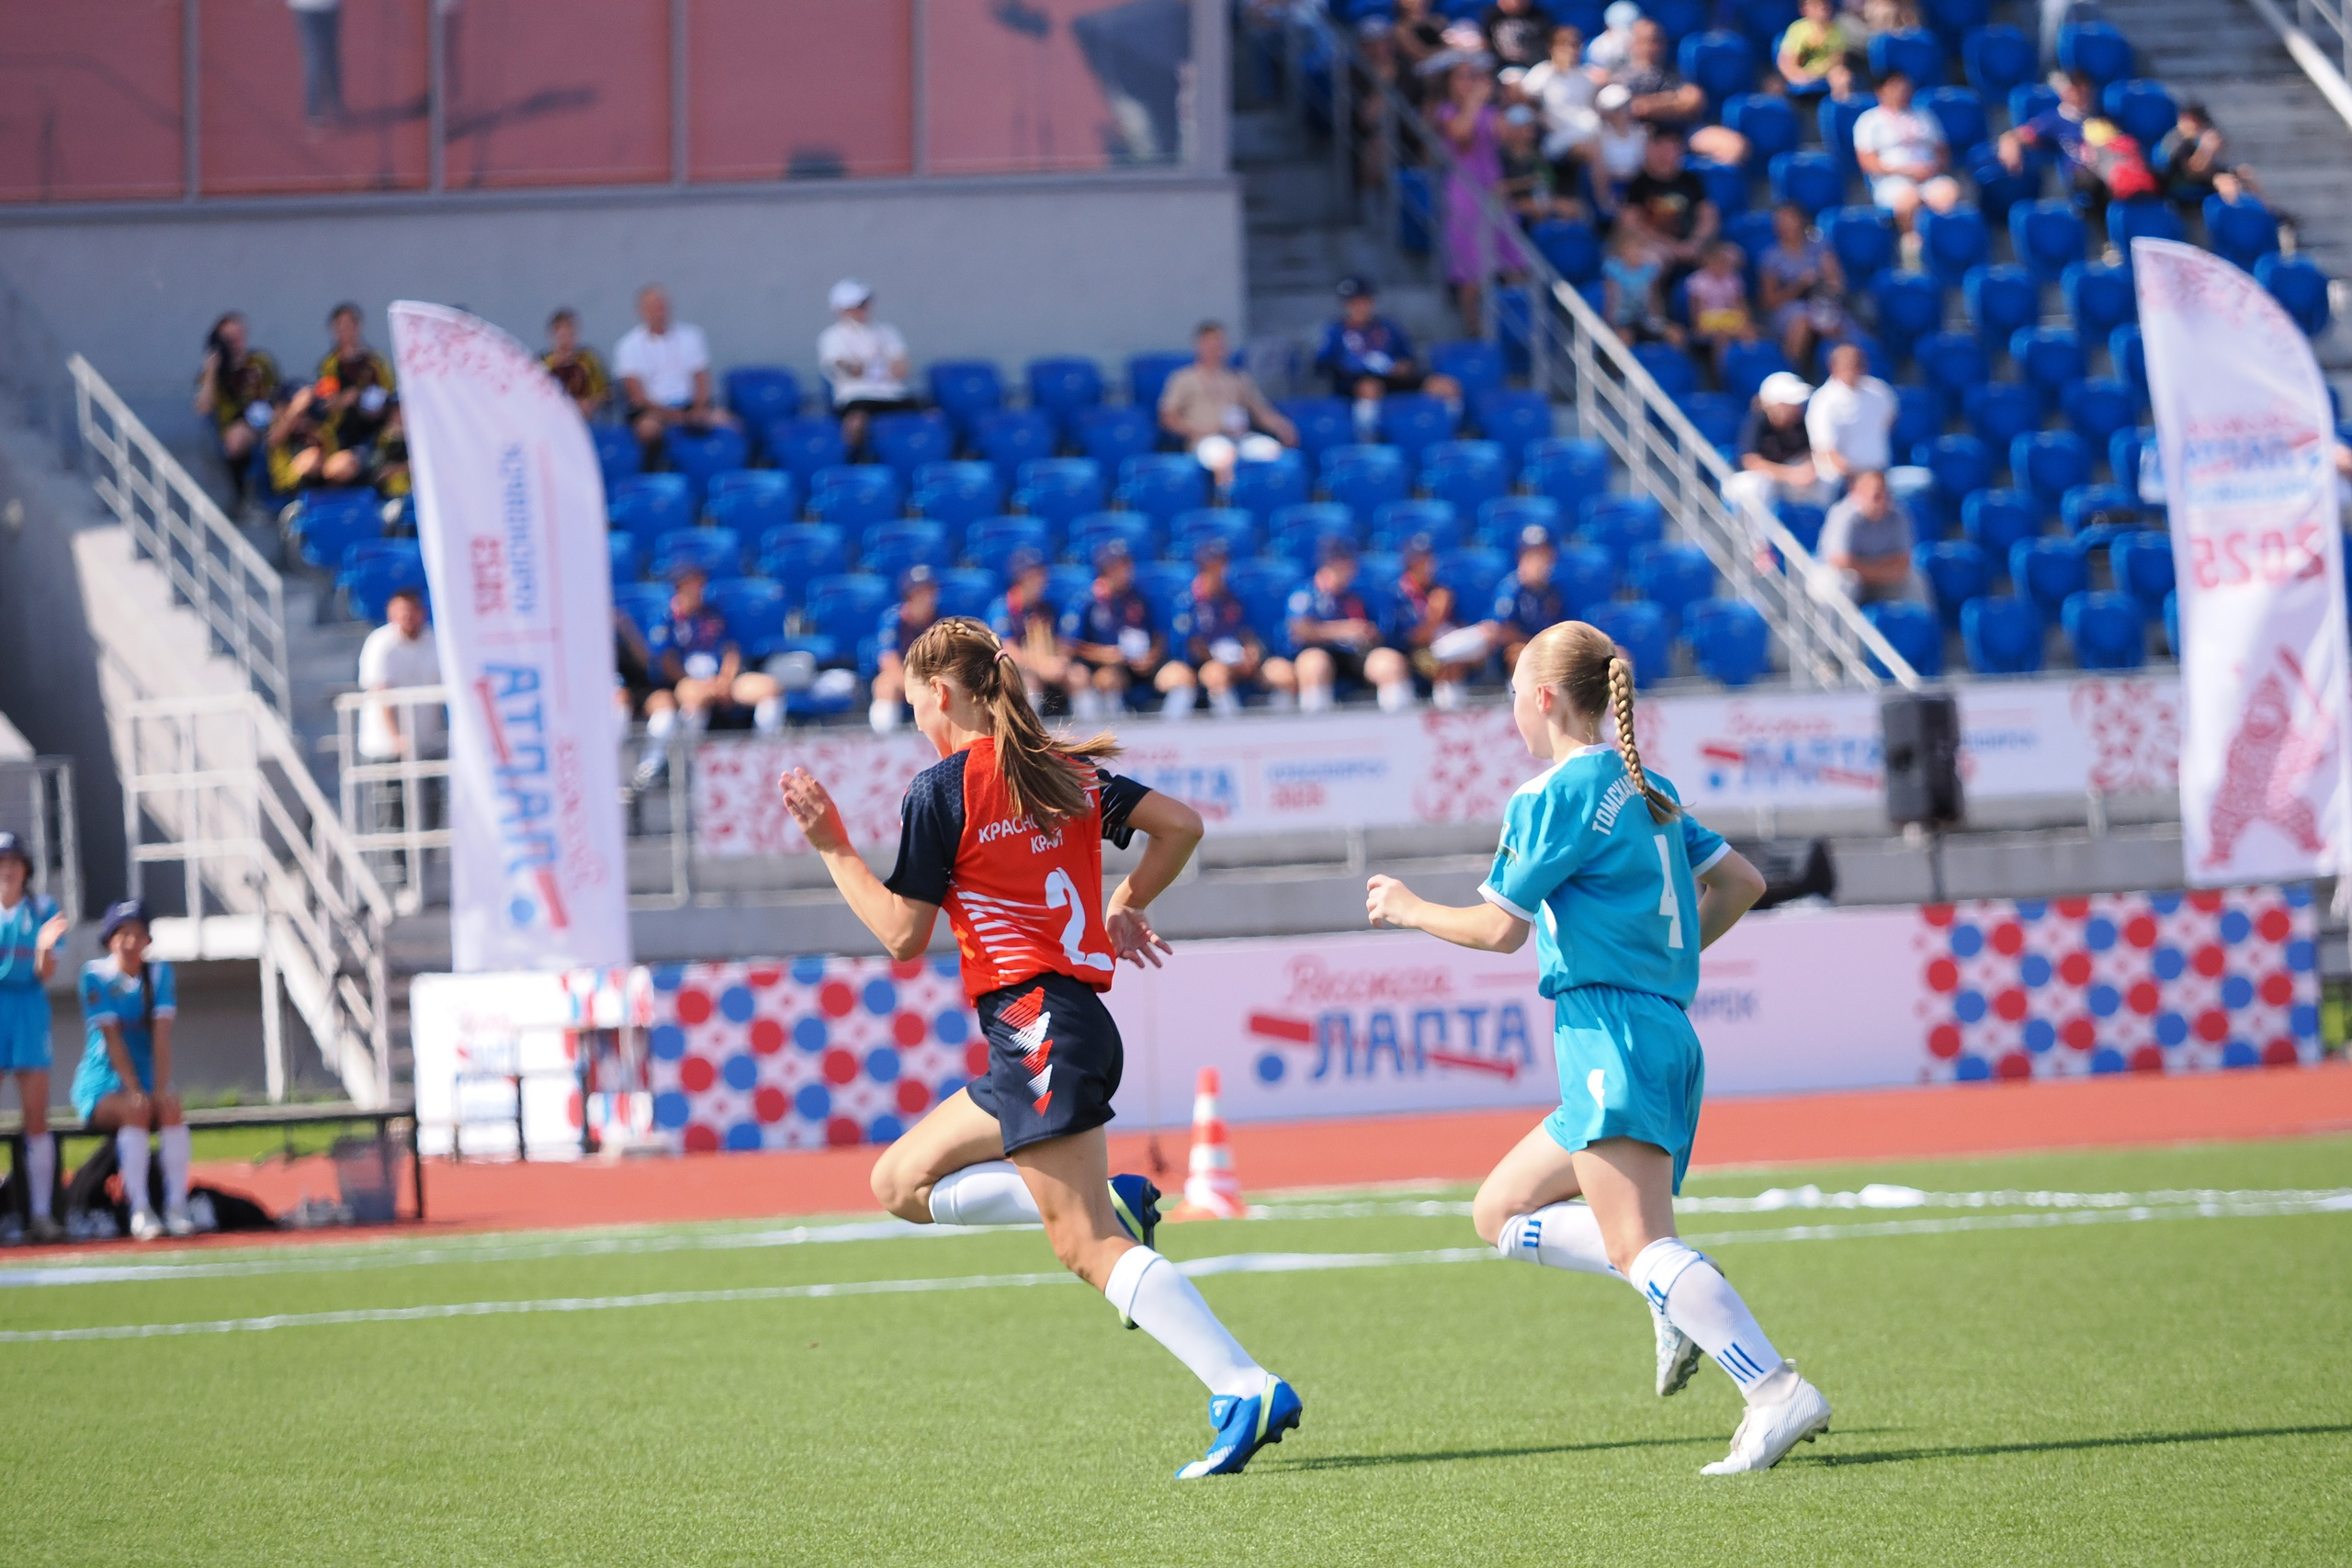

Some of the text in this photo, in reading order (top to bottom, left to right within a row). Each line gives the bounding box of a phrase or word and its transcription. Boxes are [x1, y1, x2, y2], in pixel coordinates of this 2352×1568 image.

[1045, 866, 1114, 971] 2
[1653, 834, 1684, 949] 4
[1310, 1004, 1536, 1080] ЛАПТА
